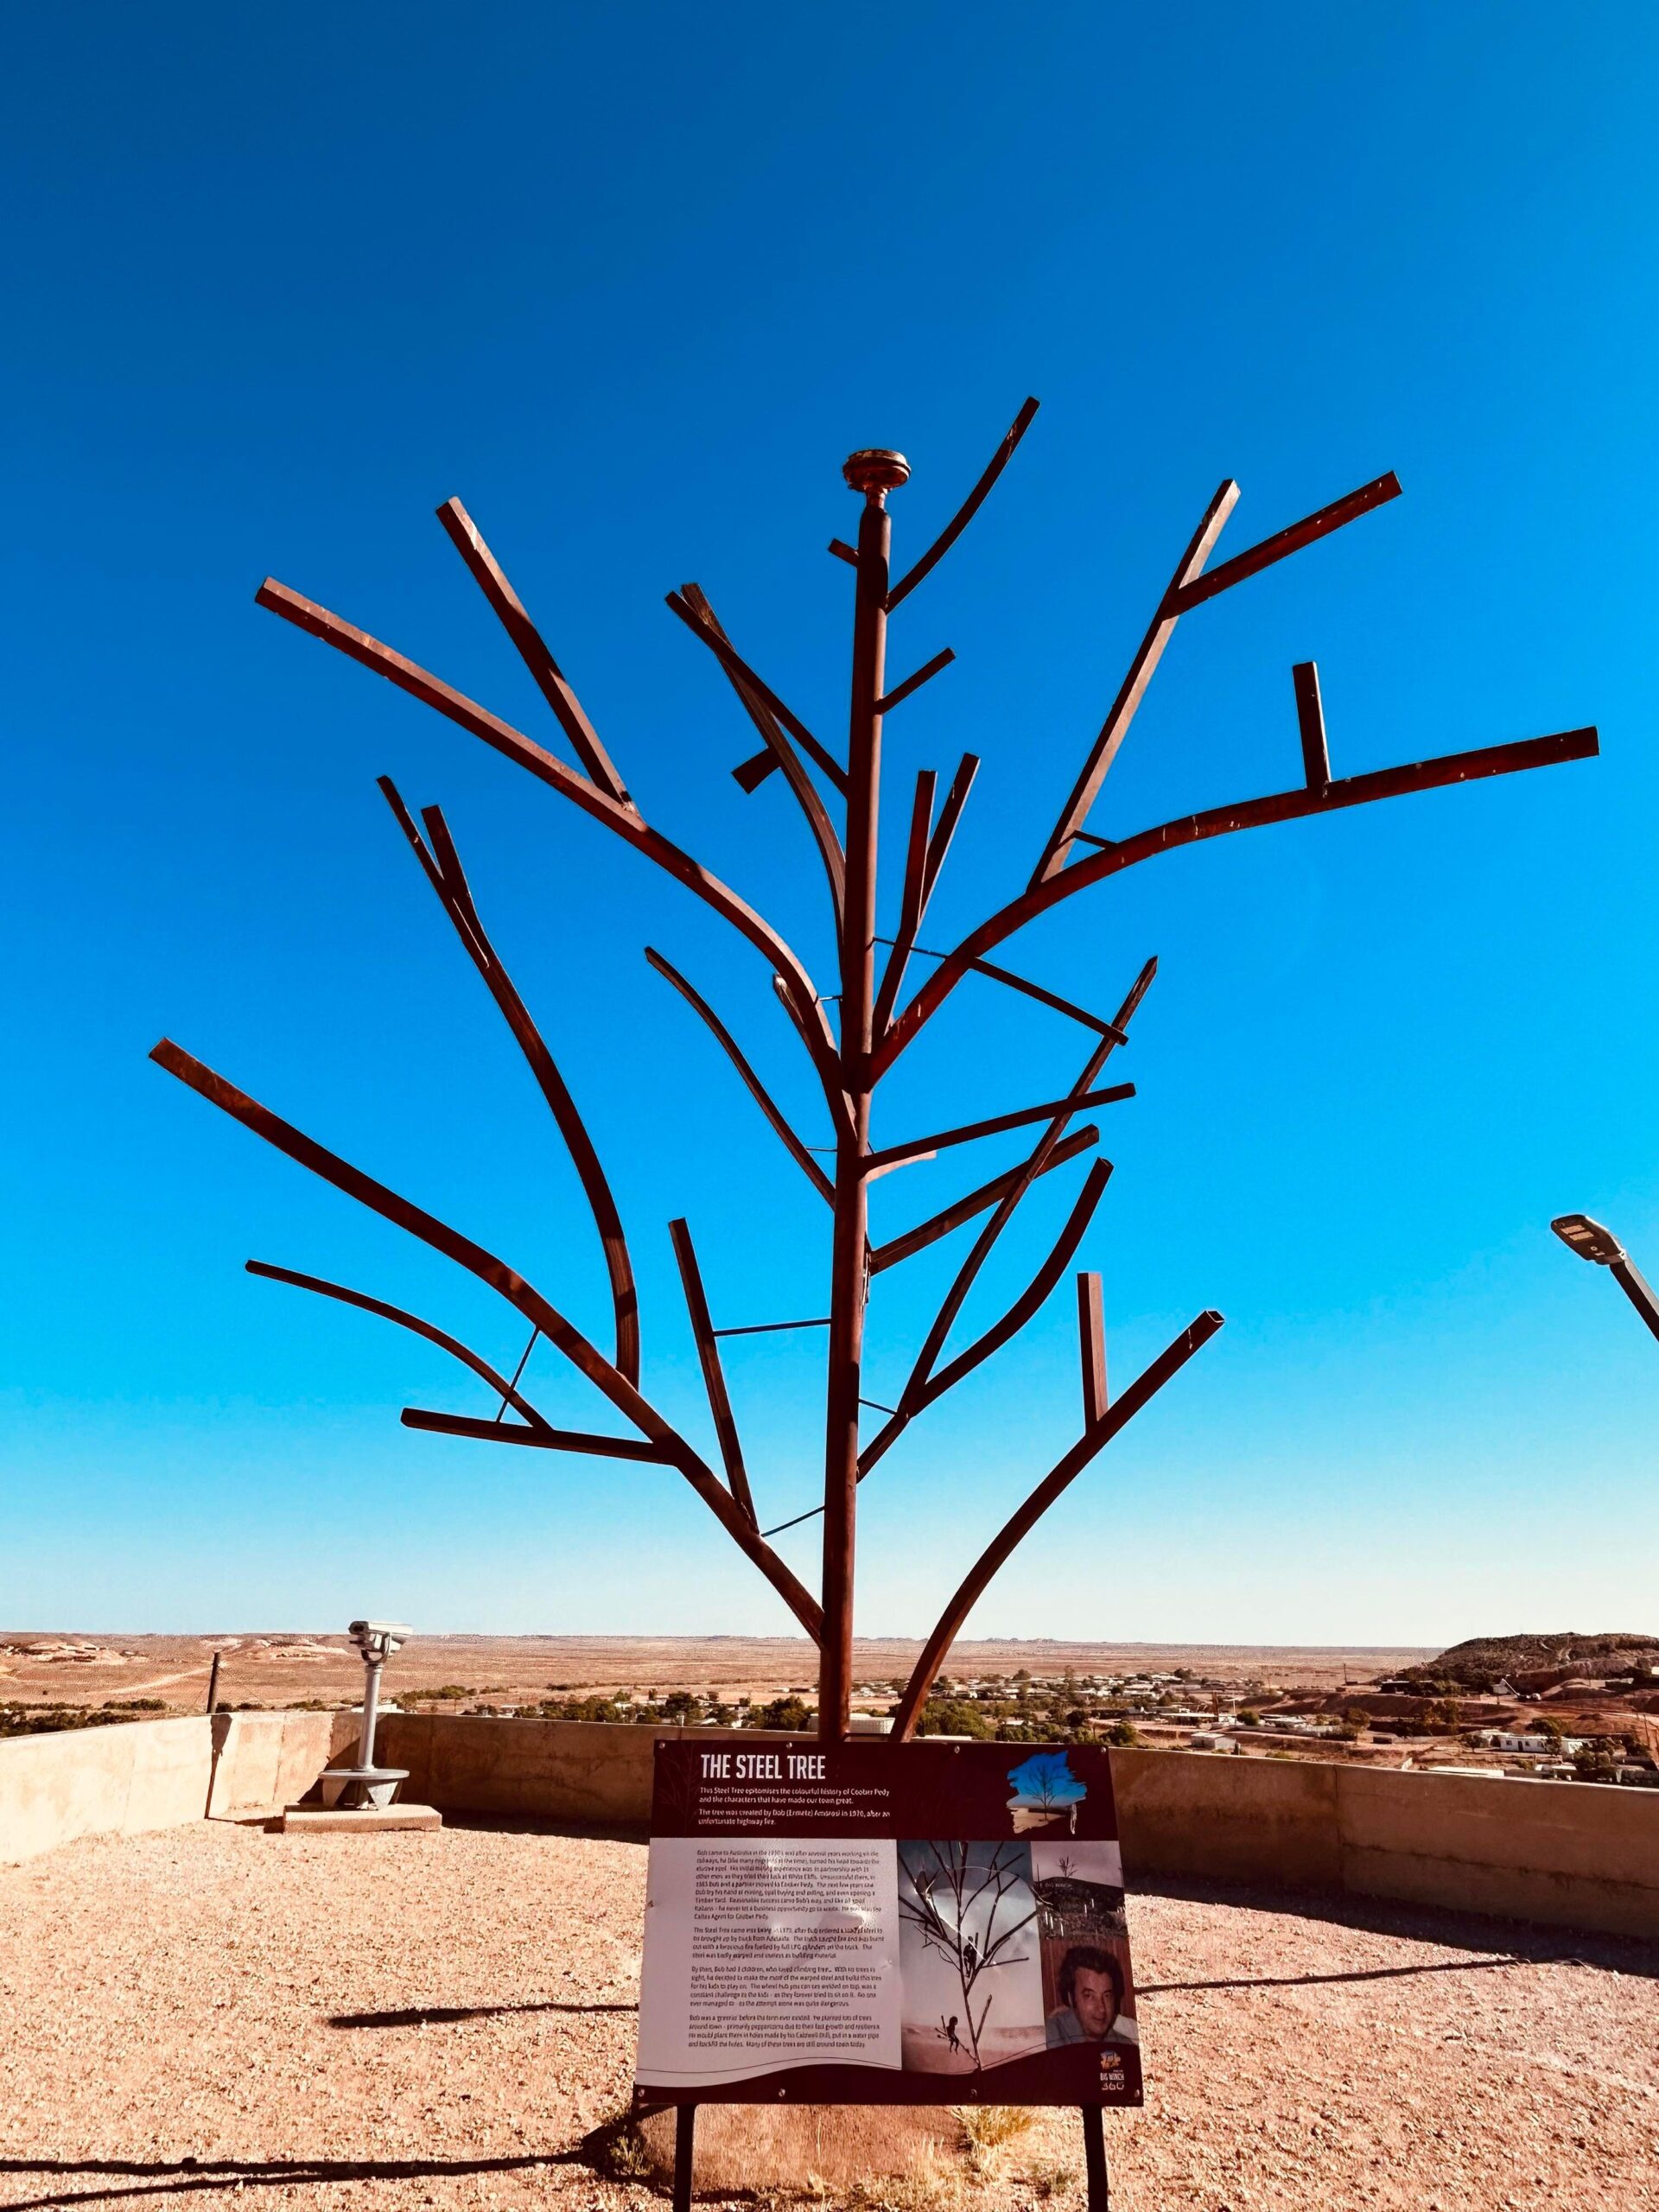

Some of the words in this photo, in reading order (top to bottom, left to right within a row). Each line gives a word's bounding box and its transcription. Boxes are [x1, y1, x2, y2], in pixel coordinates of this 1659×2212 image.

[701, 1754, 731, 1779] THE
[736, 1754, 783, 1780] STEEL
[786, 1755, 826, 1780] TREE
